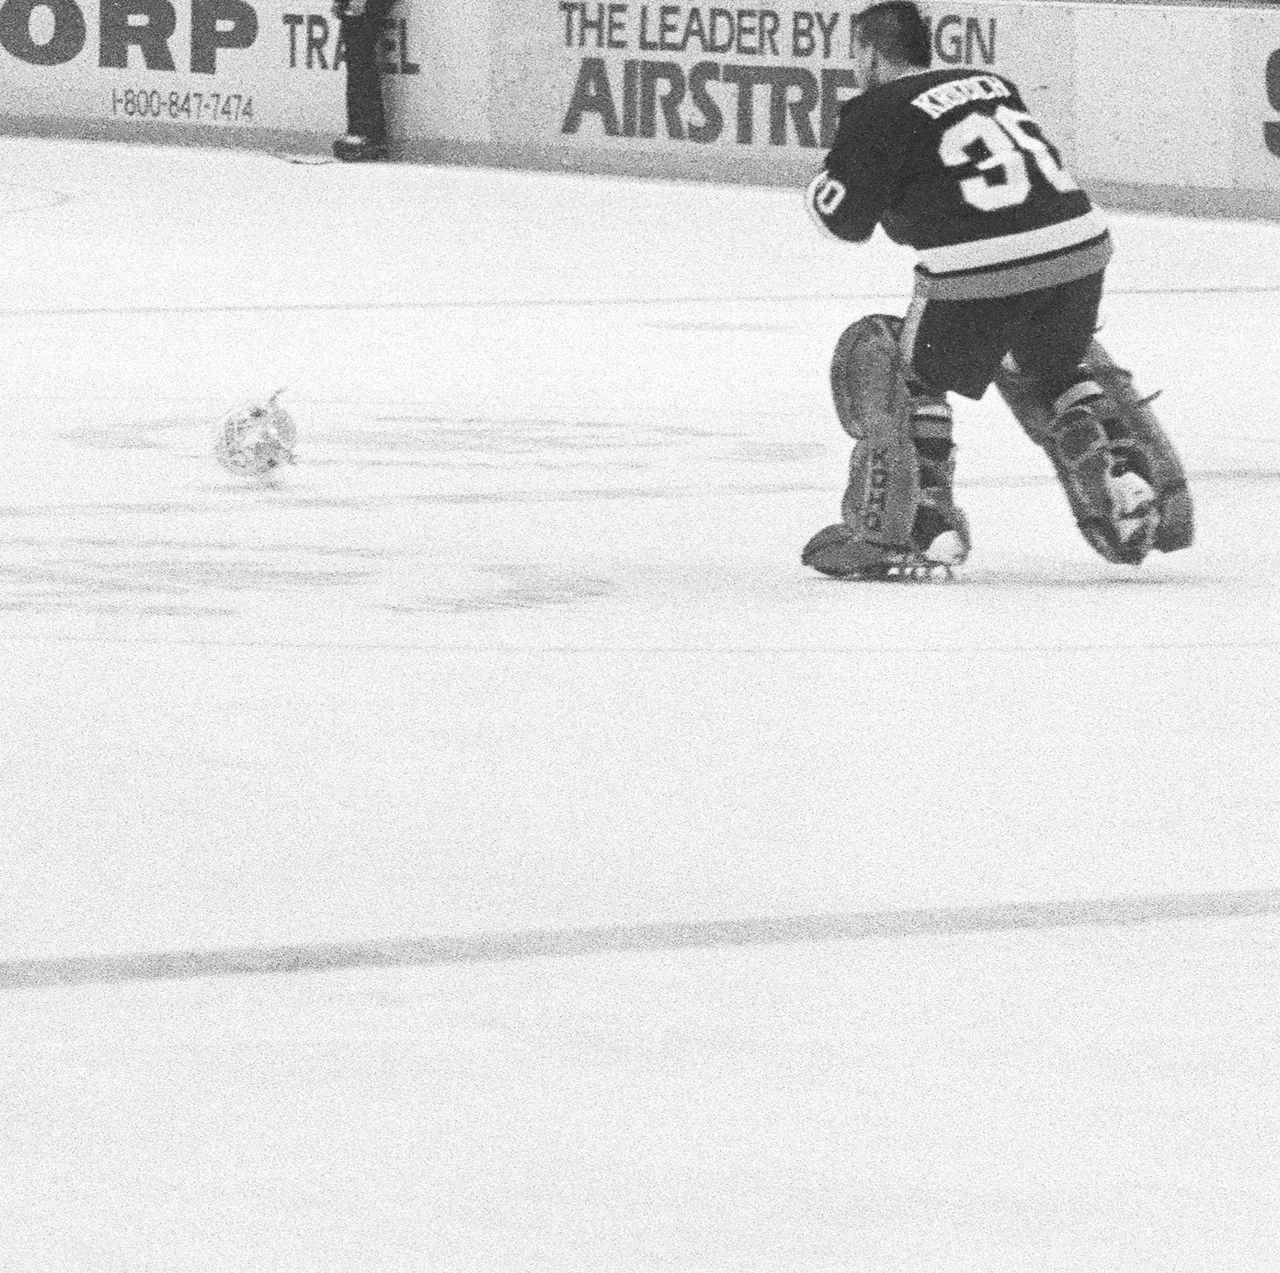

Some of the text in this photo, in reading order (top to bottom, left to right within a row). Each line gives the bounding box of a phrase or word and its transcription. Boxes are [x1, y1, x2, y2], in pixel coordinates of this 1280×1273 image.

[560, 2, 628, 49] THE
[639, 5, 781, 57] LEADER
[792, 10, 840, 59] BY
[111, 88, 254, 121] 1-800-847-7474
